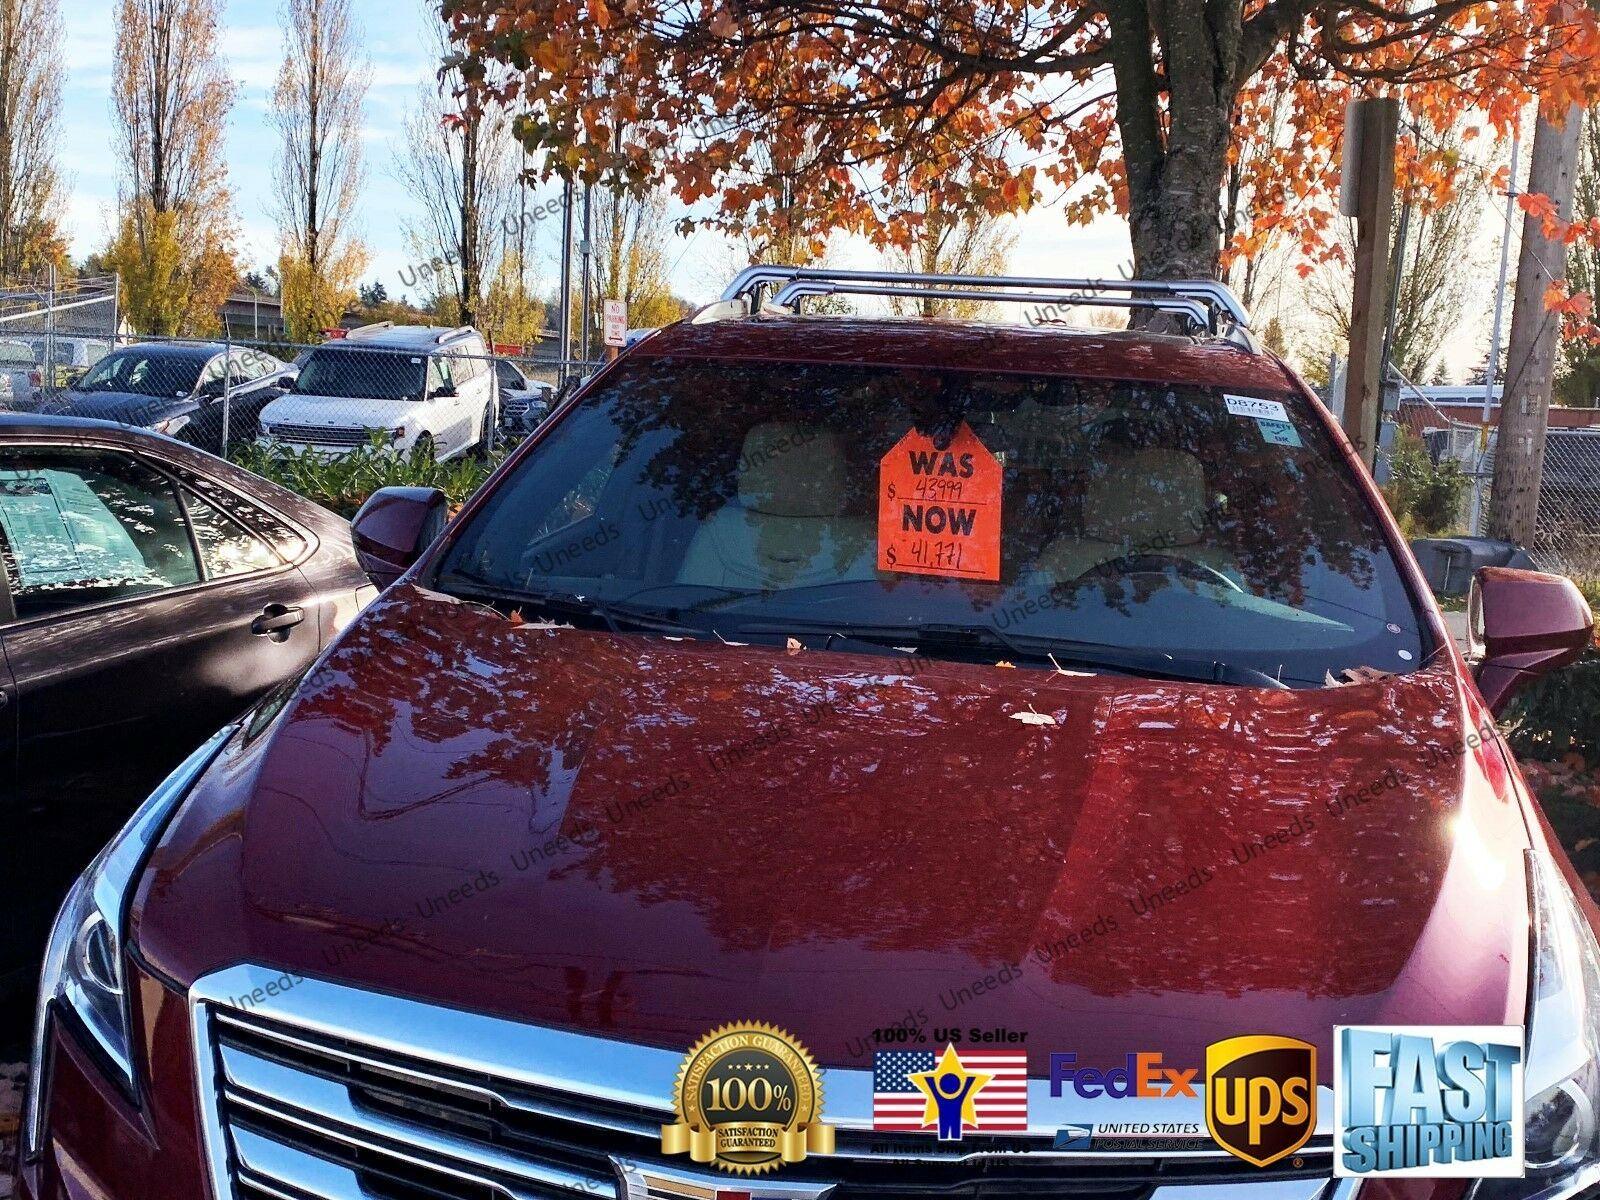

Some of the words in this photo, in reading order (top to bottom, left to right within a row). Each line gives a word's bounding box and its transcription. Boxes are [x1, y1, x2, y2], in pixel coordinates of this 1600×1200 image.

[1226, 398, 1279, 412] D8753
[908, 450, 975, 479] WAS
[887, 481, 896, 501] $
[915, 477, 963, 500] 43999
[901, 503, 977, 536] NOW
[886, 544, 897, 569] $
